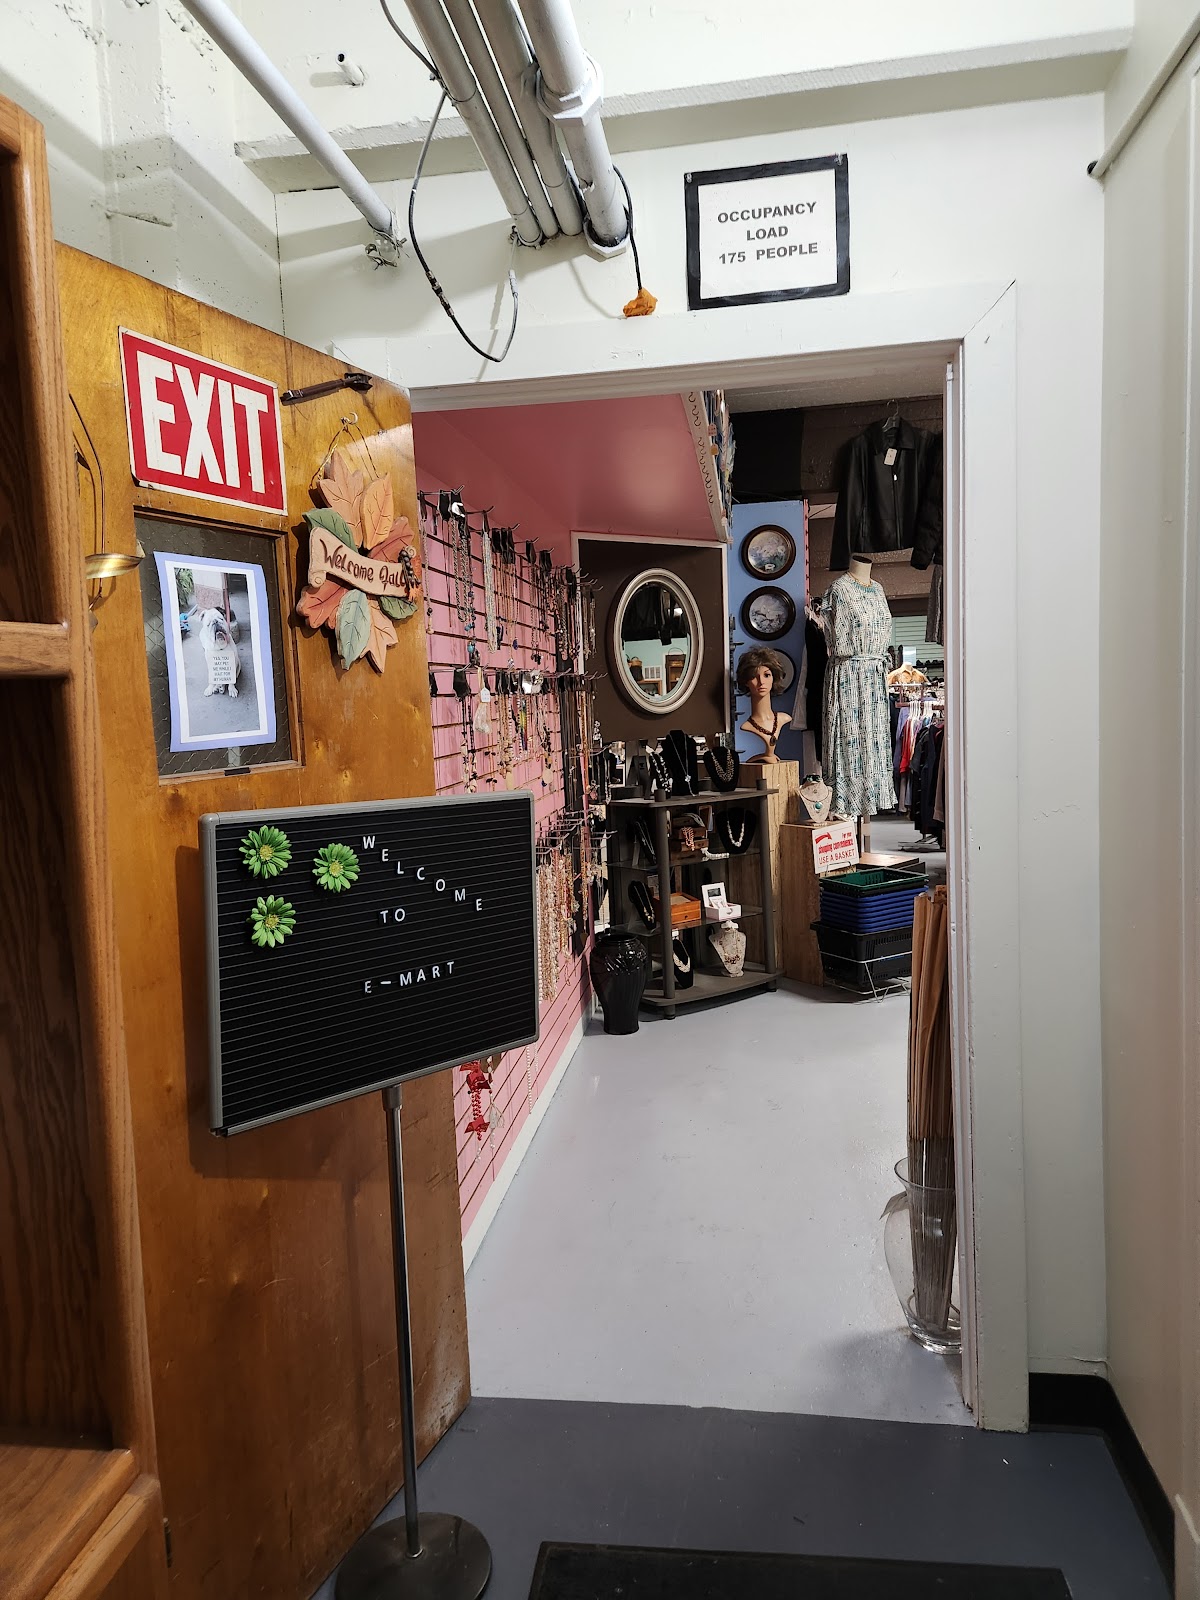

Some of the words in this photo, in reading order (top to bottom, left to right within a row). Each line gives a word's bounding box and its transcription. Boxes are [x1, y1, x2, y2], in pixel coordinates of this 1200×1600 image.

[717, 201, 817, 224] OCCUPANCY
[746, 226, 789, 241] LOAD
[718, 251, 746, 265] 175
[756, 242, 819, 261] PEOPLE
[136, 350, 269, 494] EXIT
[319, 538, 374, 583] Welcome
[818, 855, 829, 864] USE
[830, 854, 834, 862] A
[835, 849, 854, 860] BASKET
[362, 835, 483, 912] WELCOME
[380, 908, 406, 924] TO
